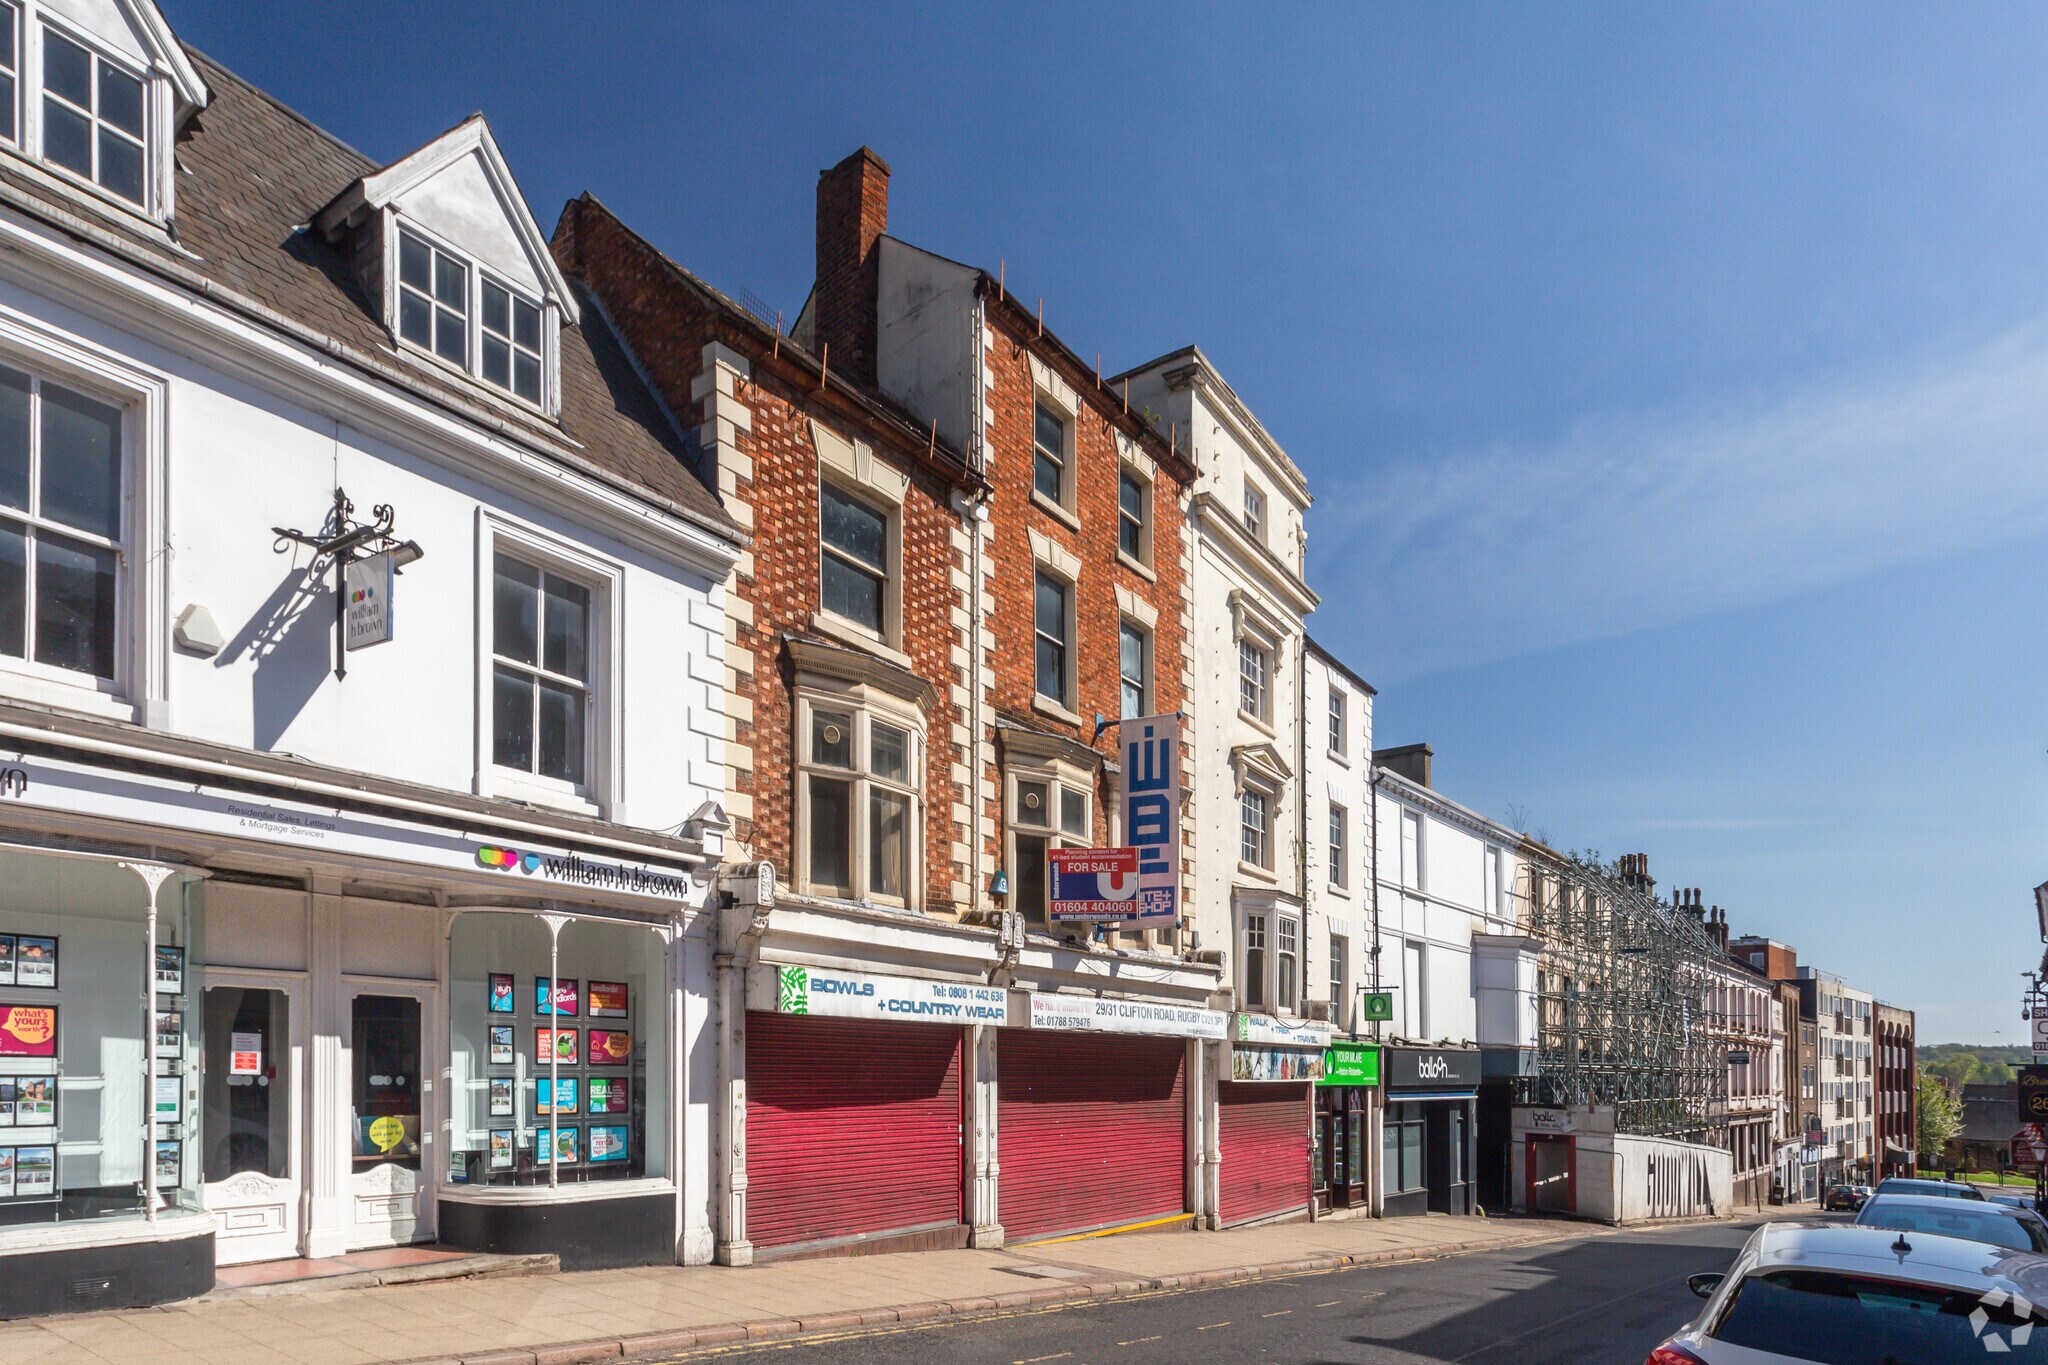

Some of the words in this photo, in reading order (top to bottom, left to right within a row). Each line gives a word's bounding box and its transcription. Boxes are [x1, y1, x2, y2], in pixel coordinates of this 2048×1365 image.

[351, 604, 379, 621] william
[351, 624, 356, 638] h
[357, 619, 382, 636] brown
[227, 805, 275, 820] Residential
[304, 818, 336, 830] Lettings
[239, 818, 246, 826] &
[248, 820, 288, 833] Mortgage
[290, 826, 325, 839] Services
[1067, 862, 1089, 872] FOR
[1091, 862, 1118, 872] SALE
[547, 855, 614, 883] william
[619, 864, 629, 885] h
[635, 866, 687, 894] brown
[1054, 902, 1088, 912] 01604
[1091, 902, 1133, 912] 404060
[810, 978, 875, 997] BOWLS
[932, 985, 947, 998] Tel:
[948, 986, 967, 999] 0808
[969, 988, 974, 999] 1
[975, 988, 989, 1001] 442
[990, 990, 1004, 1002] 636
[14, 1008, 48, 1018] what's
[888, 999, 963, 1016] COUNTRY
[965, 1006, 1005, 1020] WEAR
[1033, 1000, 1044, 1010] We
[1095, 1002, 1117, 1016] 29/31
[1119, 1004, 1152, 1019] CLIFTON
[1177, 1011, 1200, 1024] RUGBY
[14, 1017, 48, 1028] yours
[1034, 1015, 1046, 1026] Tel:
[1047, 1015, 1067, 1027] 01788
[1249, 1017, 1268, 1027] WALK
[1275, 1025, 1290, 1035] TREK
[1296, 1034, 1318, 1044] TRAVEL
[1337, 1050, 1349, 1062] YOUR
[1418, 1055, 1448, 1079] balloon
[590, 1085, 613, 1095] REAL
[1645, 1149, 1707, 1218] GOODWILL
